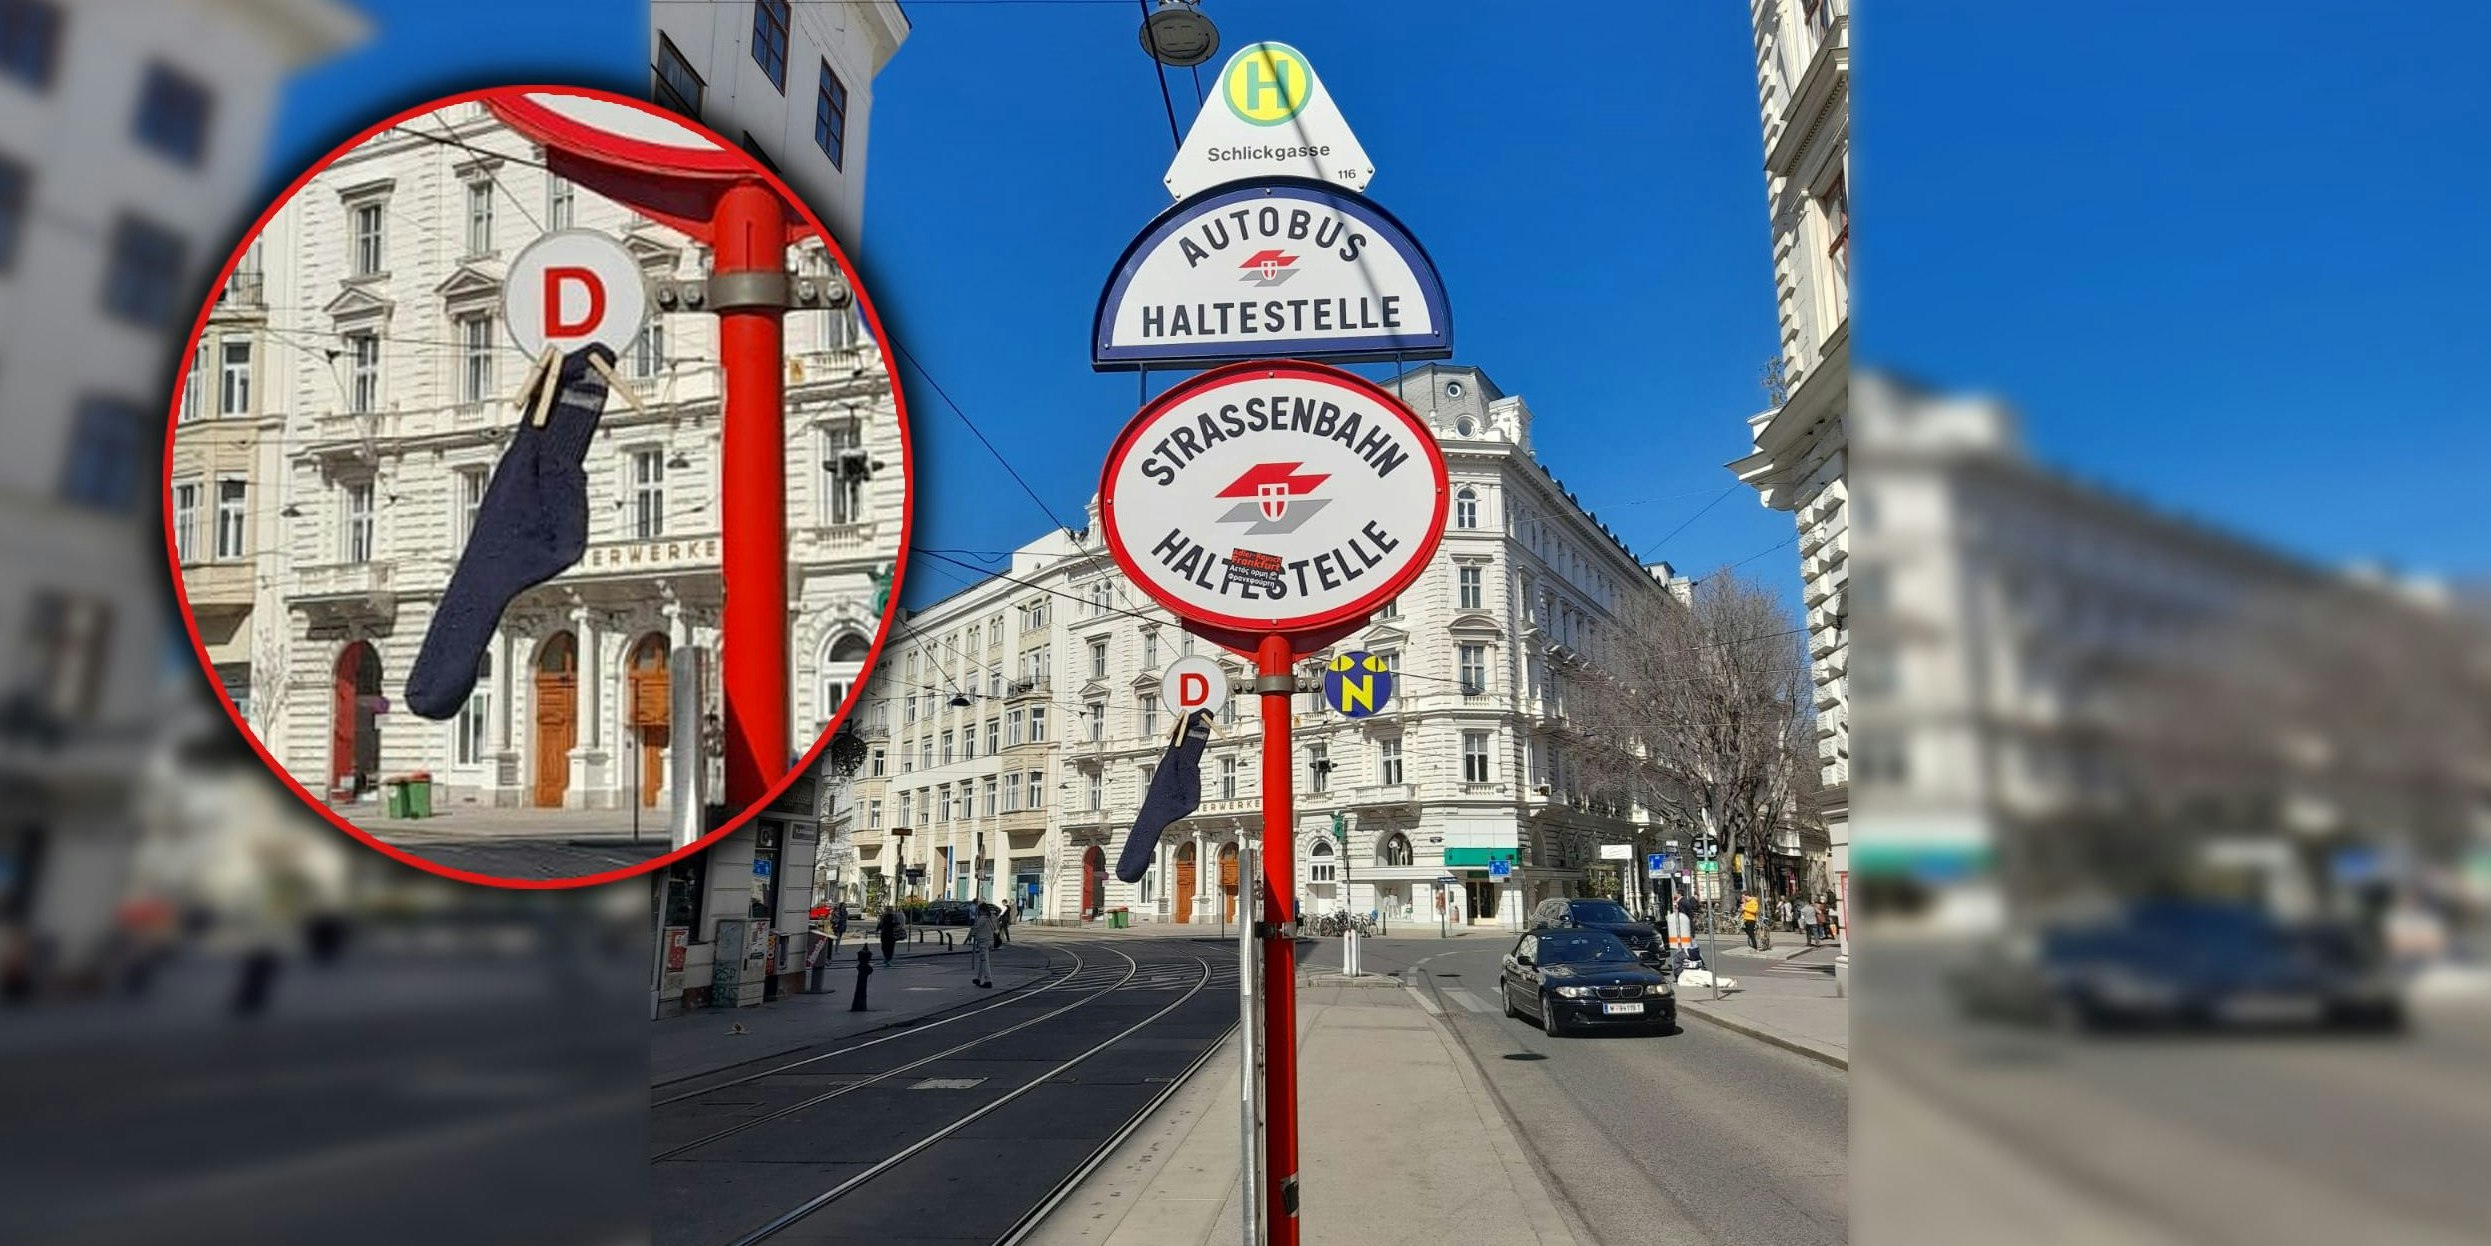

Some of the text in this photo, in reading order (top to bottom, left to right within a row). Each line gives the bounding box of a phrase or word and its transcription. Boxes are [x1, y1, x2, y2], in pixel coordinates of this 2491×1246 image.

[1246, 60, 1289, 111] H
[1207, 142, 1331, 163] Schlickgasse
[1337, 169, 1357, 179] 116
[1178, 206, 1368, 268] AUTOBUS
[544, 266, 607, 338] D
[1142, 295, 1402, 338] HALTESTELLE
[1140, 396, 1410, 487] STRASSENBAHN
[581, 540, 716, 567] ERWERKE
[1231, 556, 1281, 571] Frankfurt
[1179, 672, 1210, 707] D
[1341, 674, 1373, 713] N
[1198, 799, 1261, 812] ERWERKE
